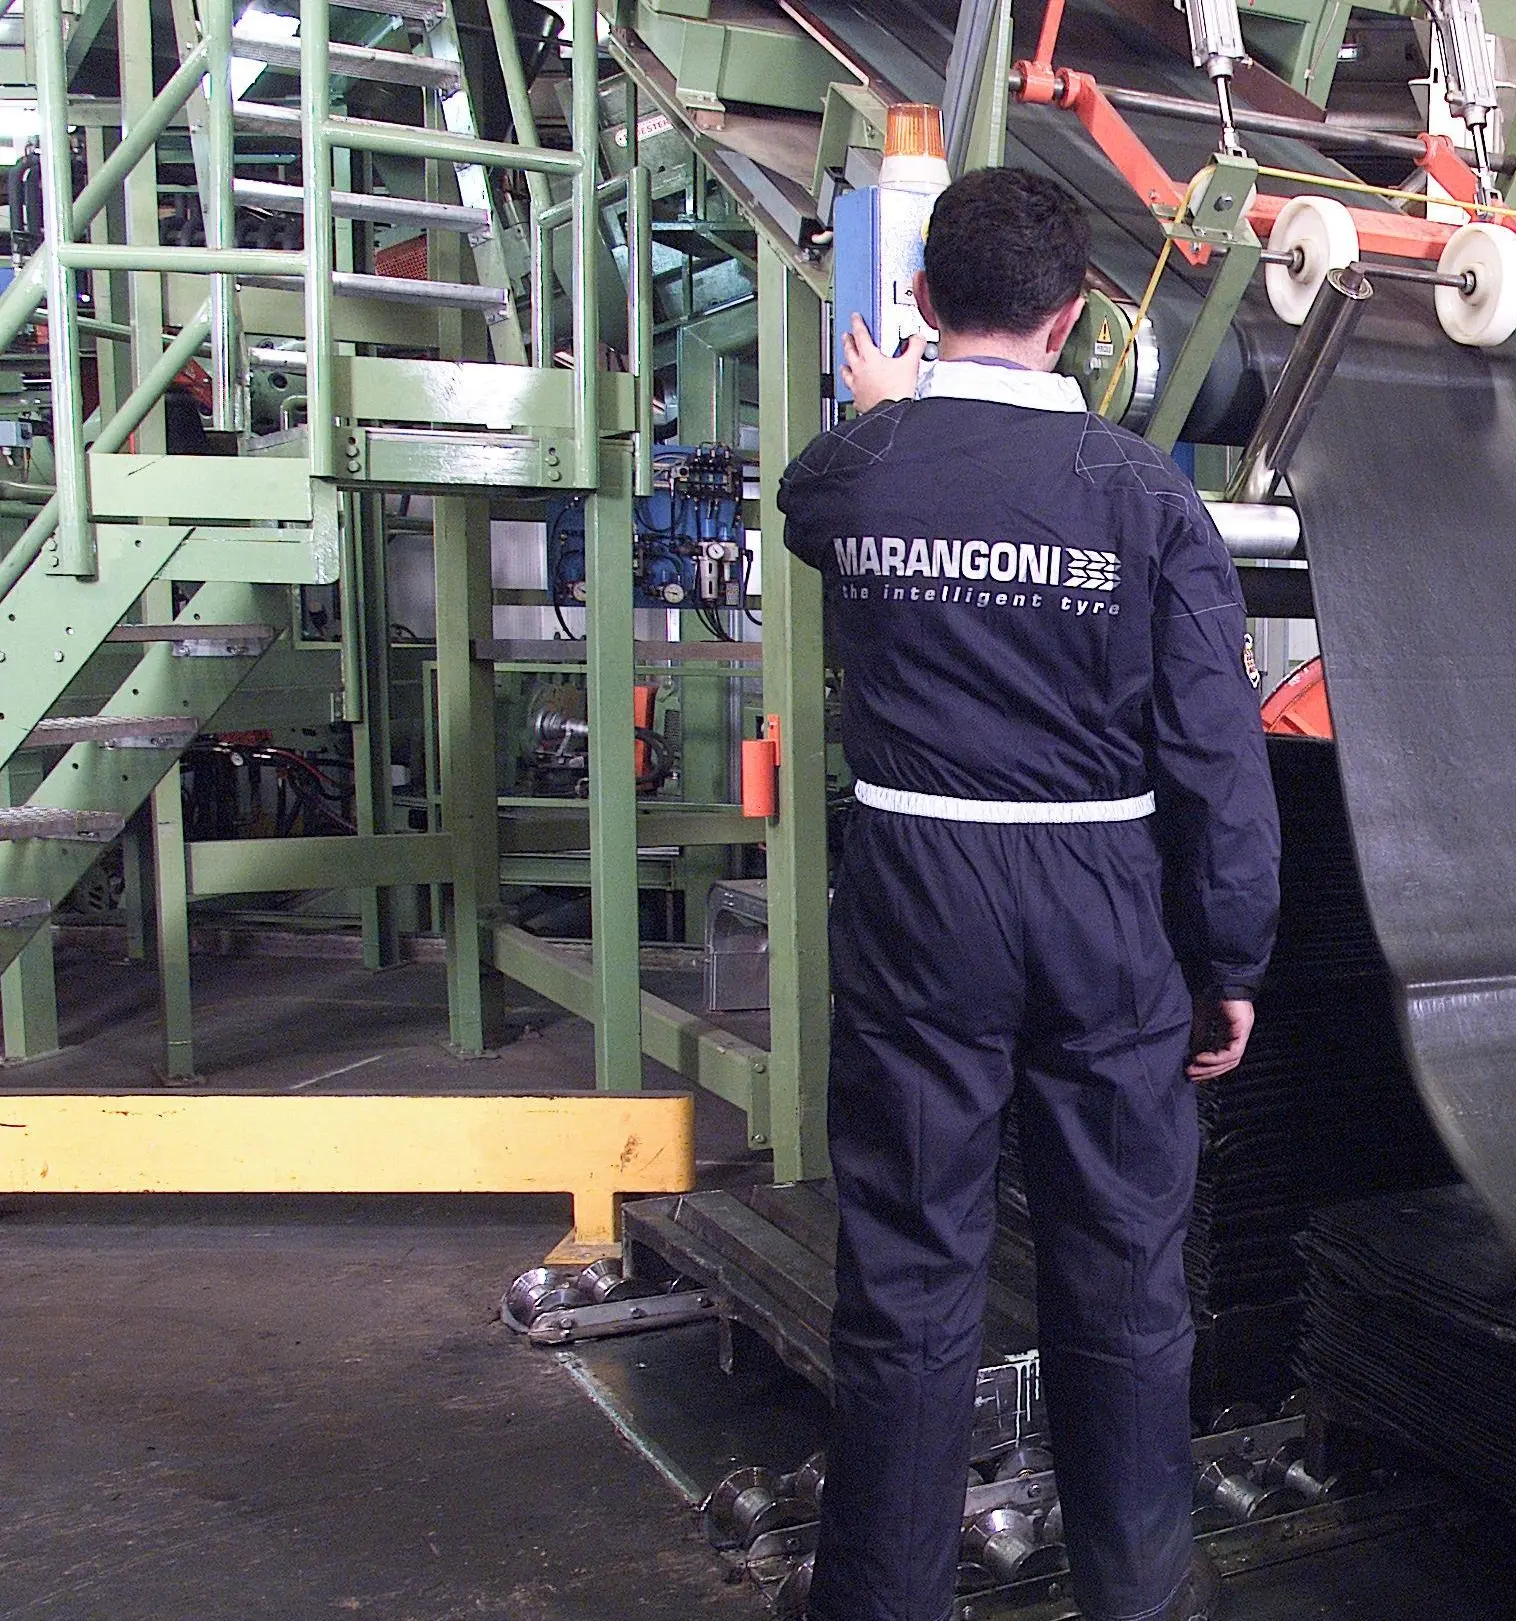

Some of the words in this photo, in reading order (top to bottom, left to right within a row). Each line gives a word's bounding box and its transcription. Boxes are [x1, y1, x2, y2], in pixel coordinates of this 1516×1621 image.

[833, 536, 1062, 586] MARANGONI
[842, 584, 869, 599] the
[883, 584, 1043, 608] intelligent
[1060, 596, 1121, 616] tyre
